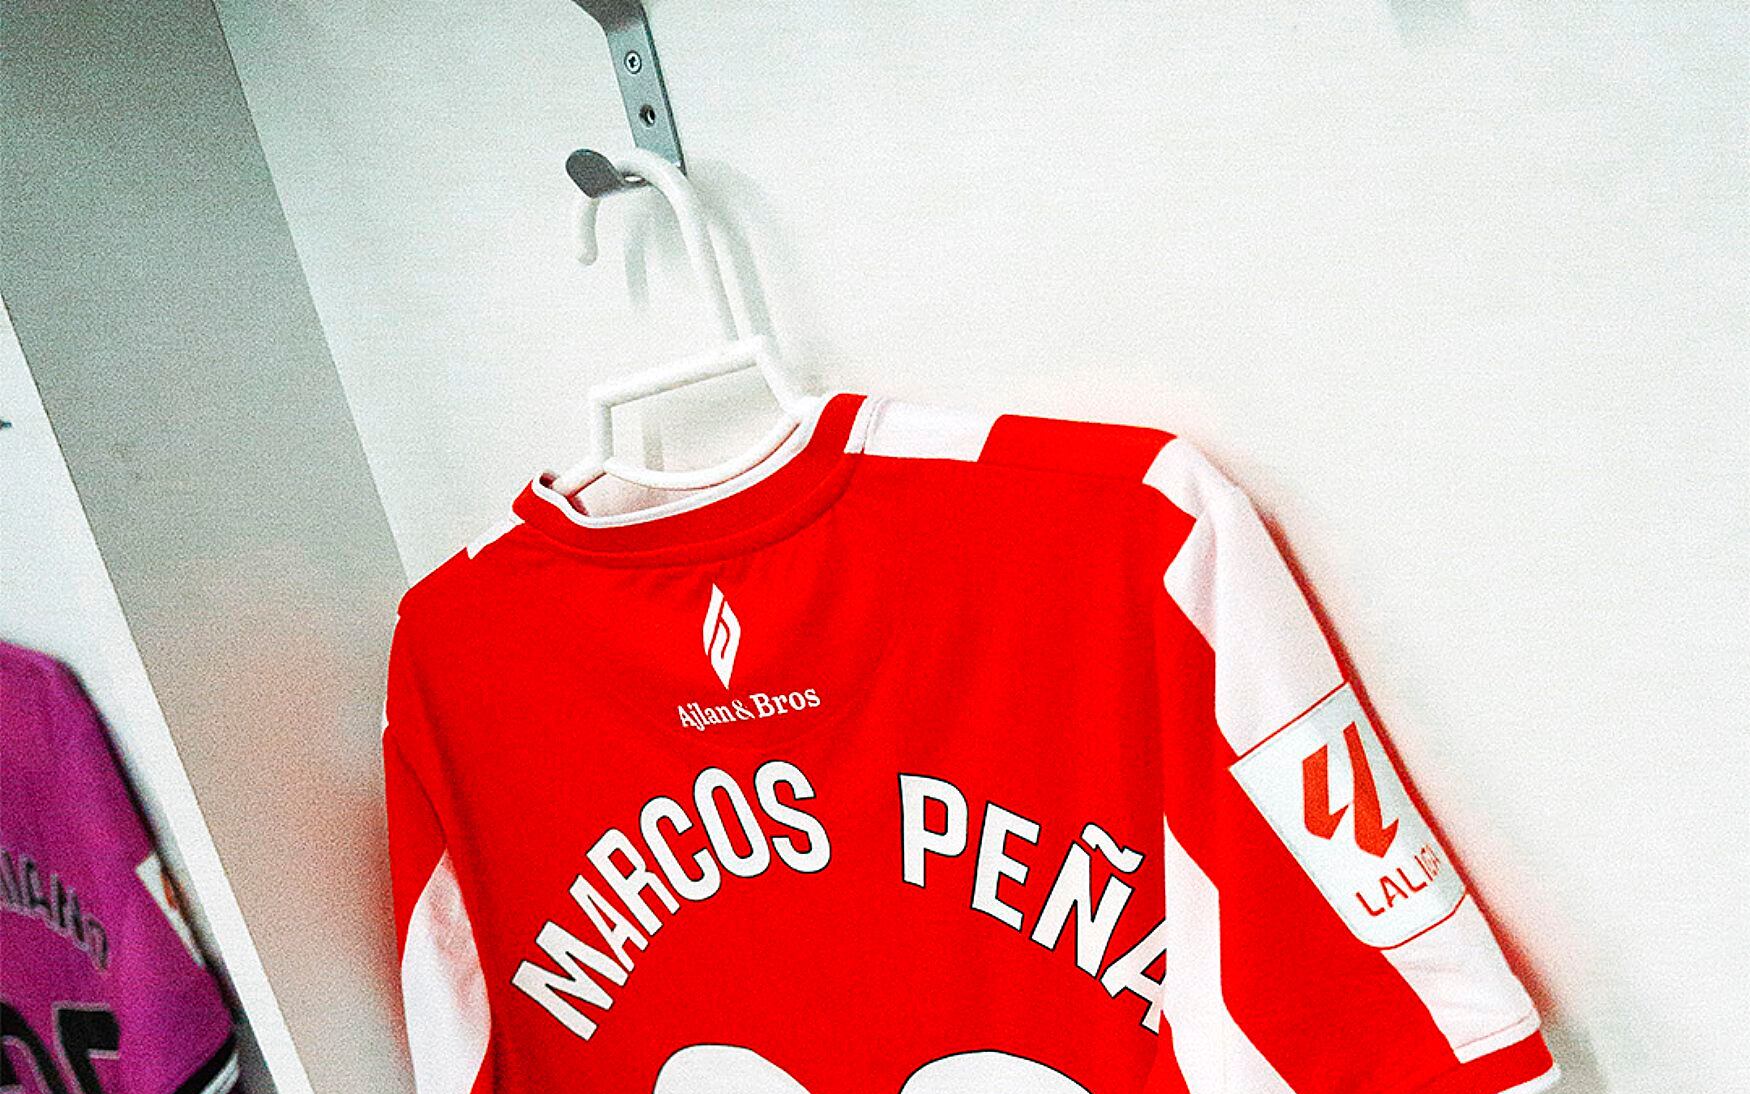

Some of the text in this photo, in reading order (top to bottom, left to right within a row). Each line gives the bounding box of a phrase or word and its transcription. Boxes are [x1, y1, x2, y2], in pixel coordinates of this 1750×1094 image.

[677, 688, 821, 732] Ajlan & Bros
[511, 759, 1167, 1041] MARCOS PEÑA
